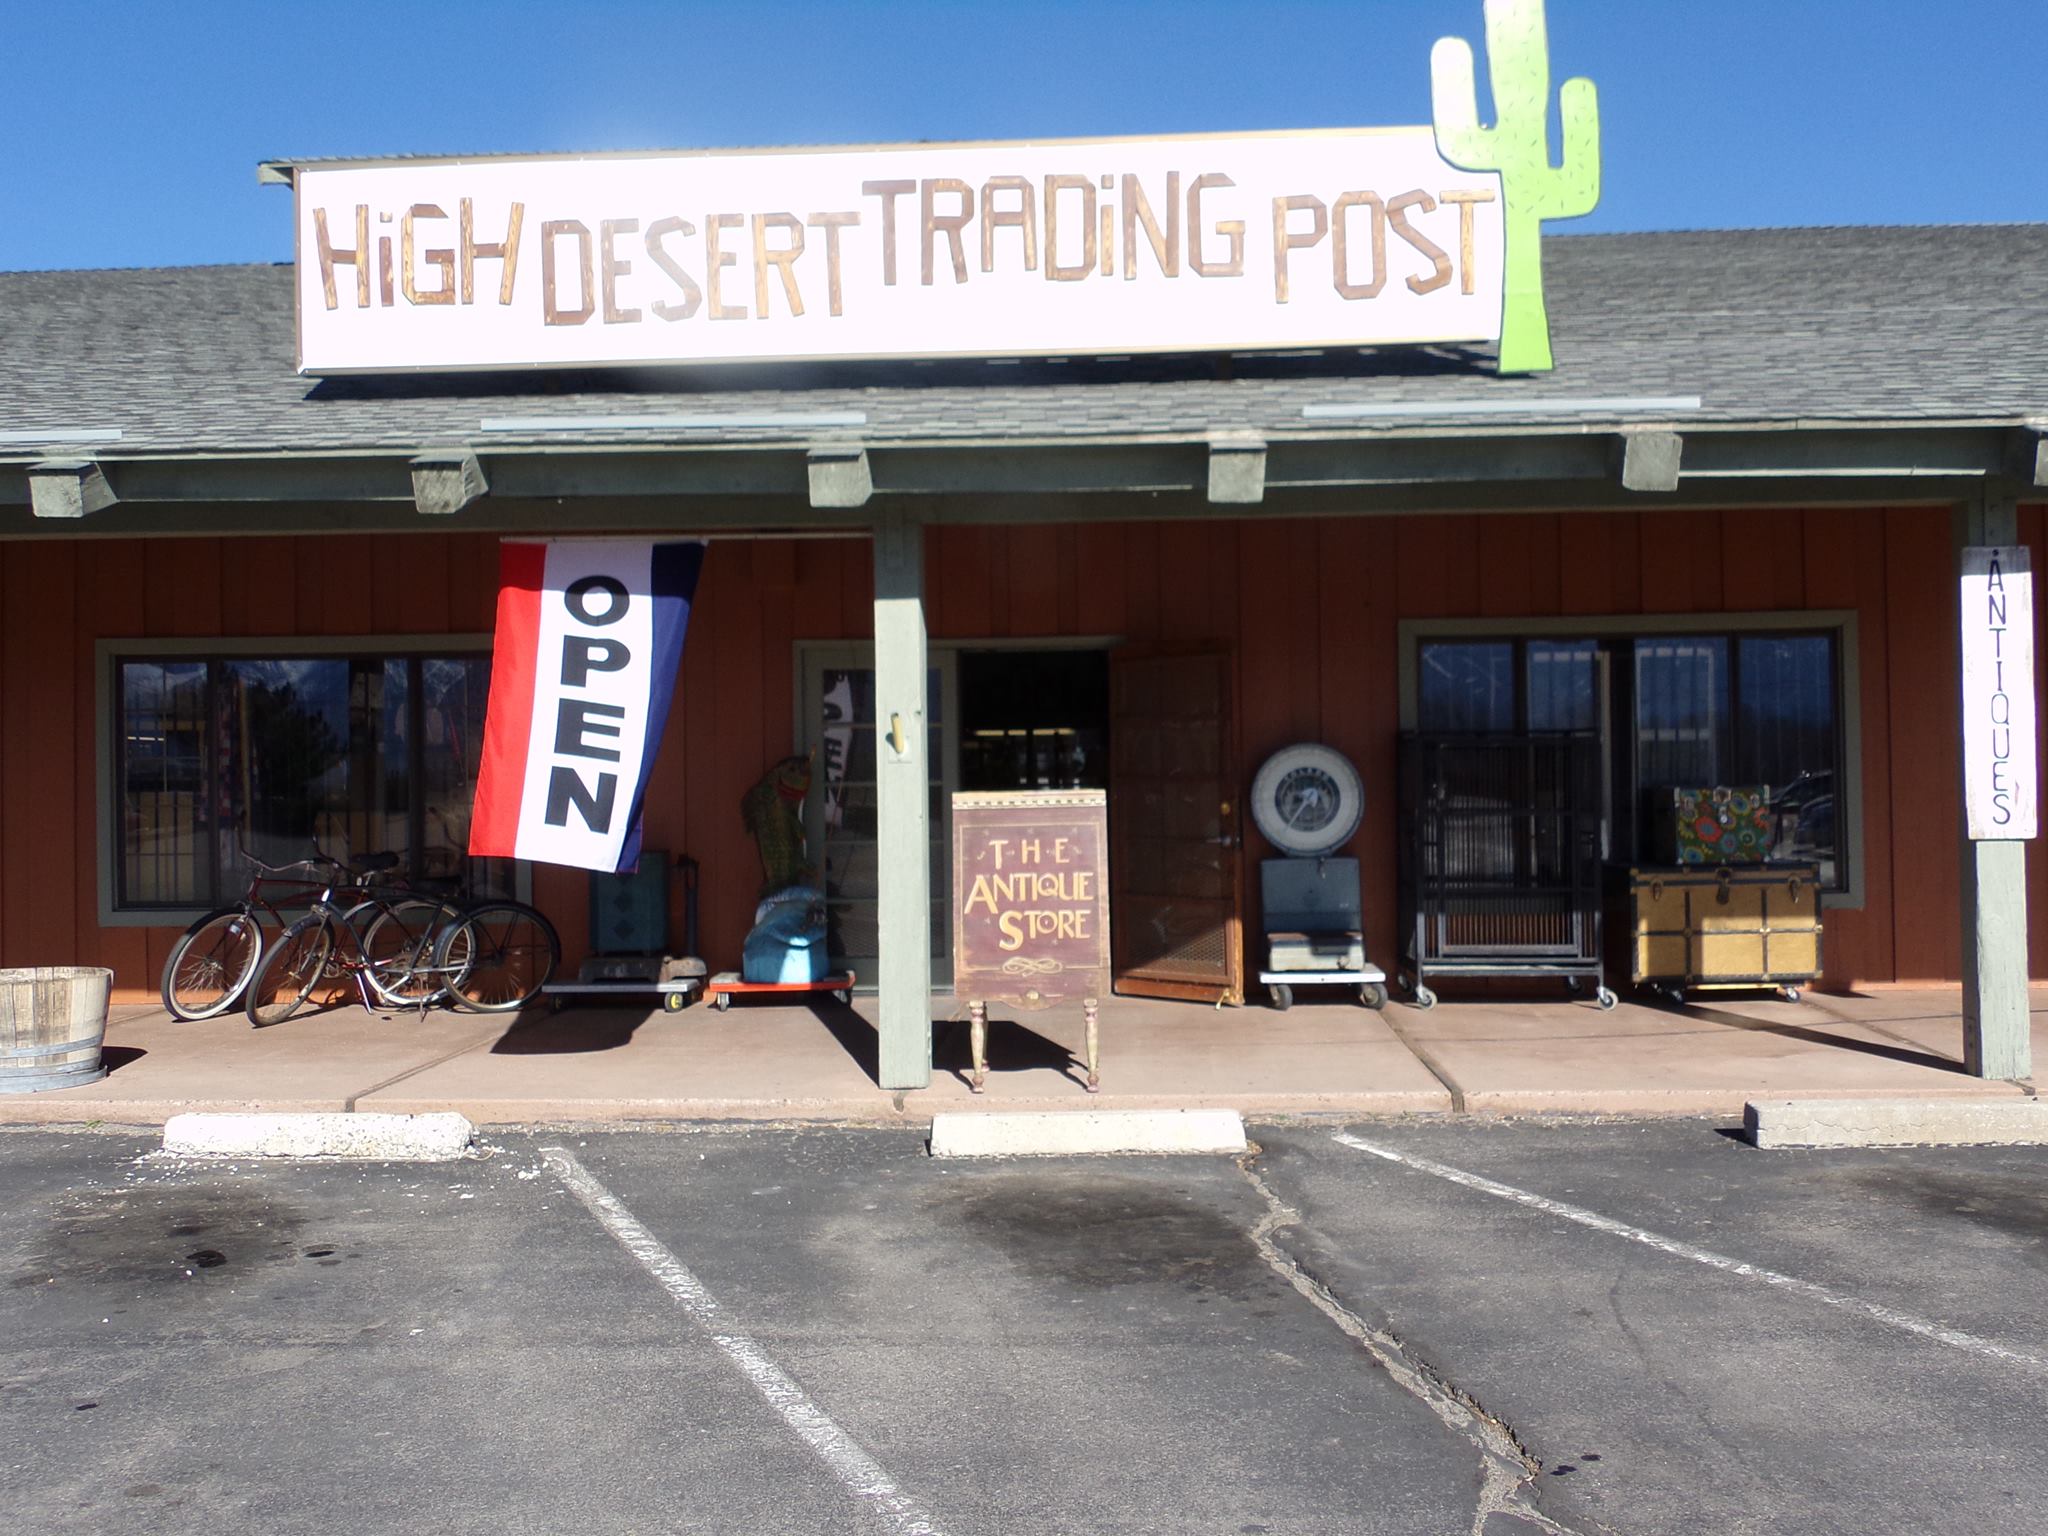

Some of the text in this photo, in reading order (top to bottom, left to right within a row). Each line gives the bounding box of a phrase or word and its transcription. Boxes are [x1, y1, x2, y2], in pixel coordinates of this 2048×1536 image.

[541, 211, 861, 327] DESERT
[1272, 188, 1496, 304] POST
[544, 575, 632, 835] OPEN
[1987, 558, 2011, 825] ANTIQUES
[964, 871, 1094, 915] ANTIQUE
[988, 838, 1070, 869] THE
[998, 909, 1092, 951] STORE
